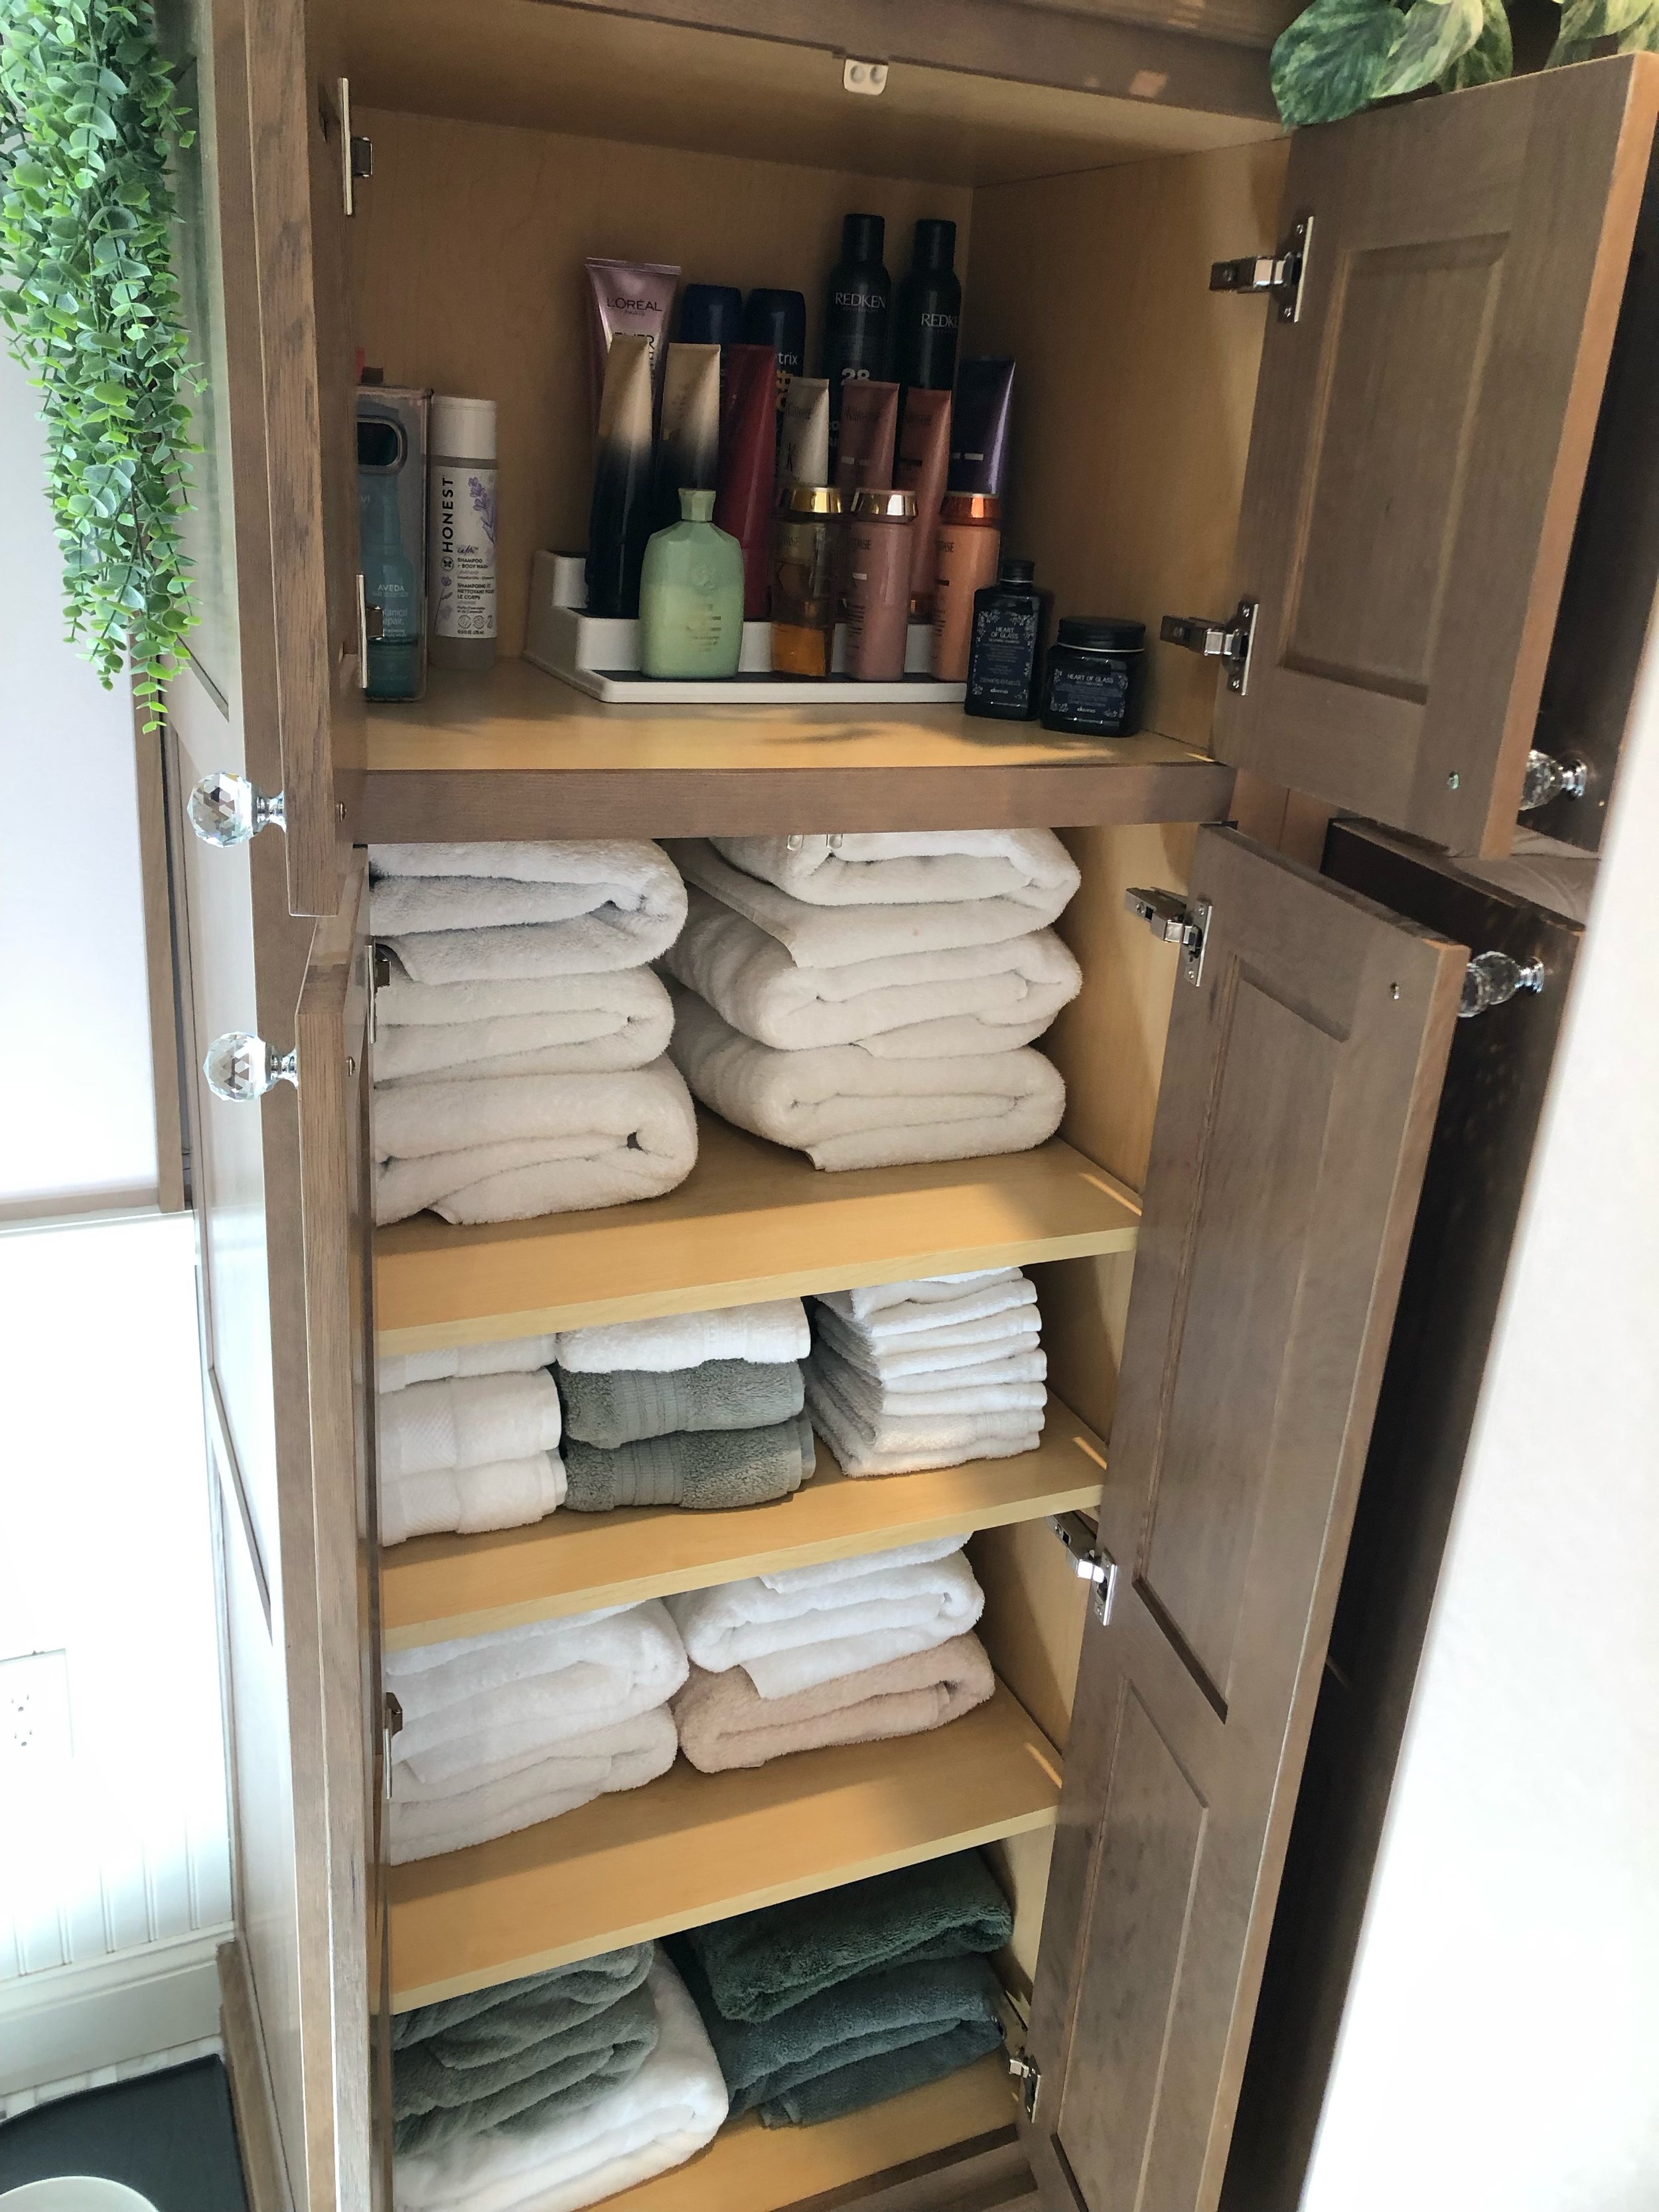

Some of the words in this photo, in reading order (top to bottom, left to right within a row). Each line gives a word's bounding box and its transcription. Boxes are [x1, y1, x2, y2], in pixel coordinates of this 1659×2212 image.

[835, 291, 886, 309] REDKEN
[777, 351, 798, 365] trix
[442, 477, 453, 553] HONEST
[382, 608, 407, 617] tanical
[384, 617, 404, 627] epair.
